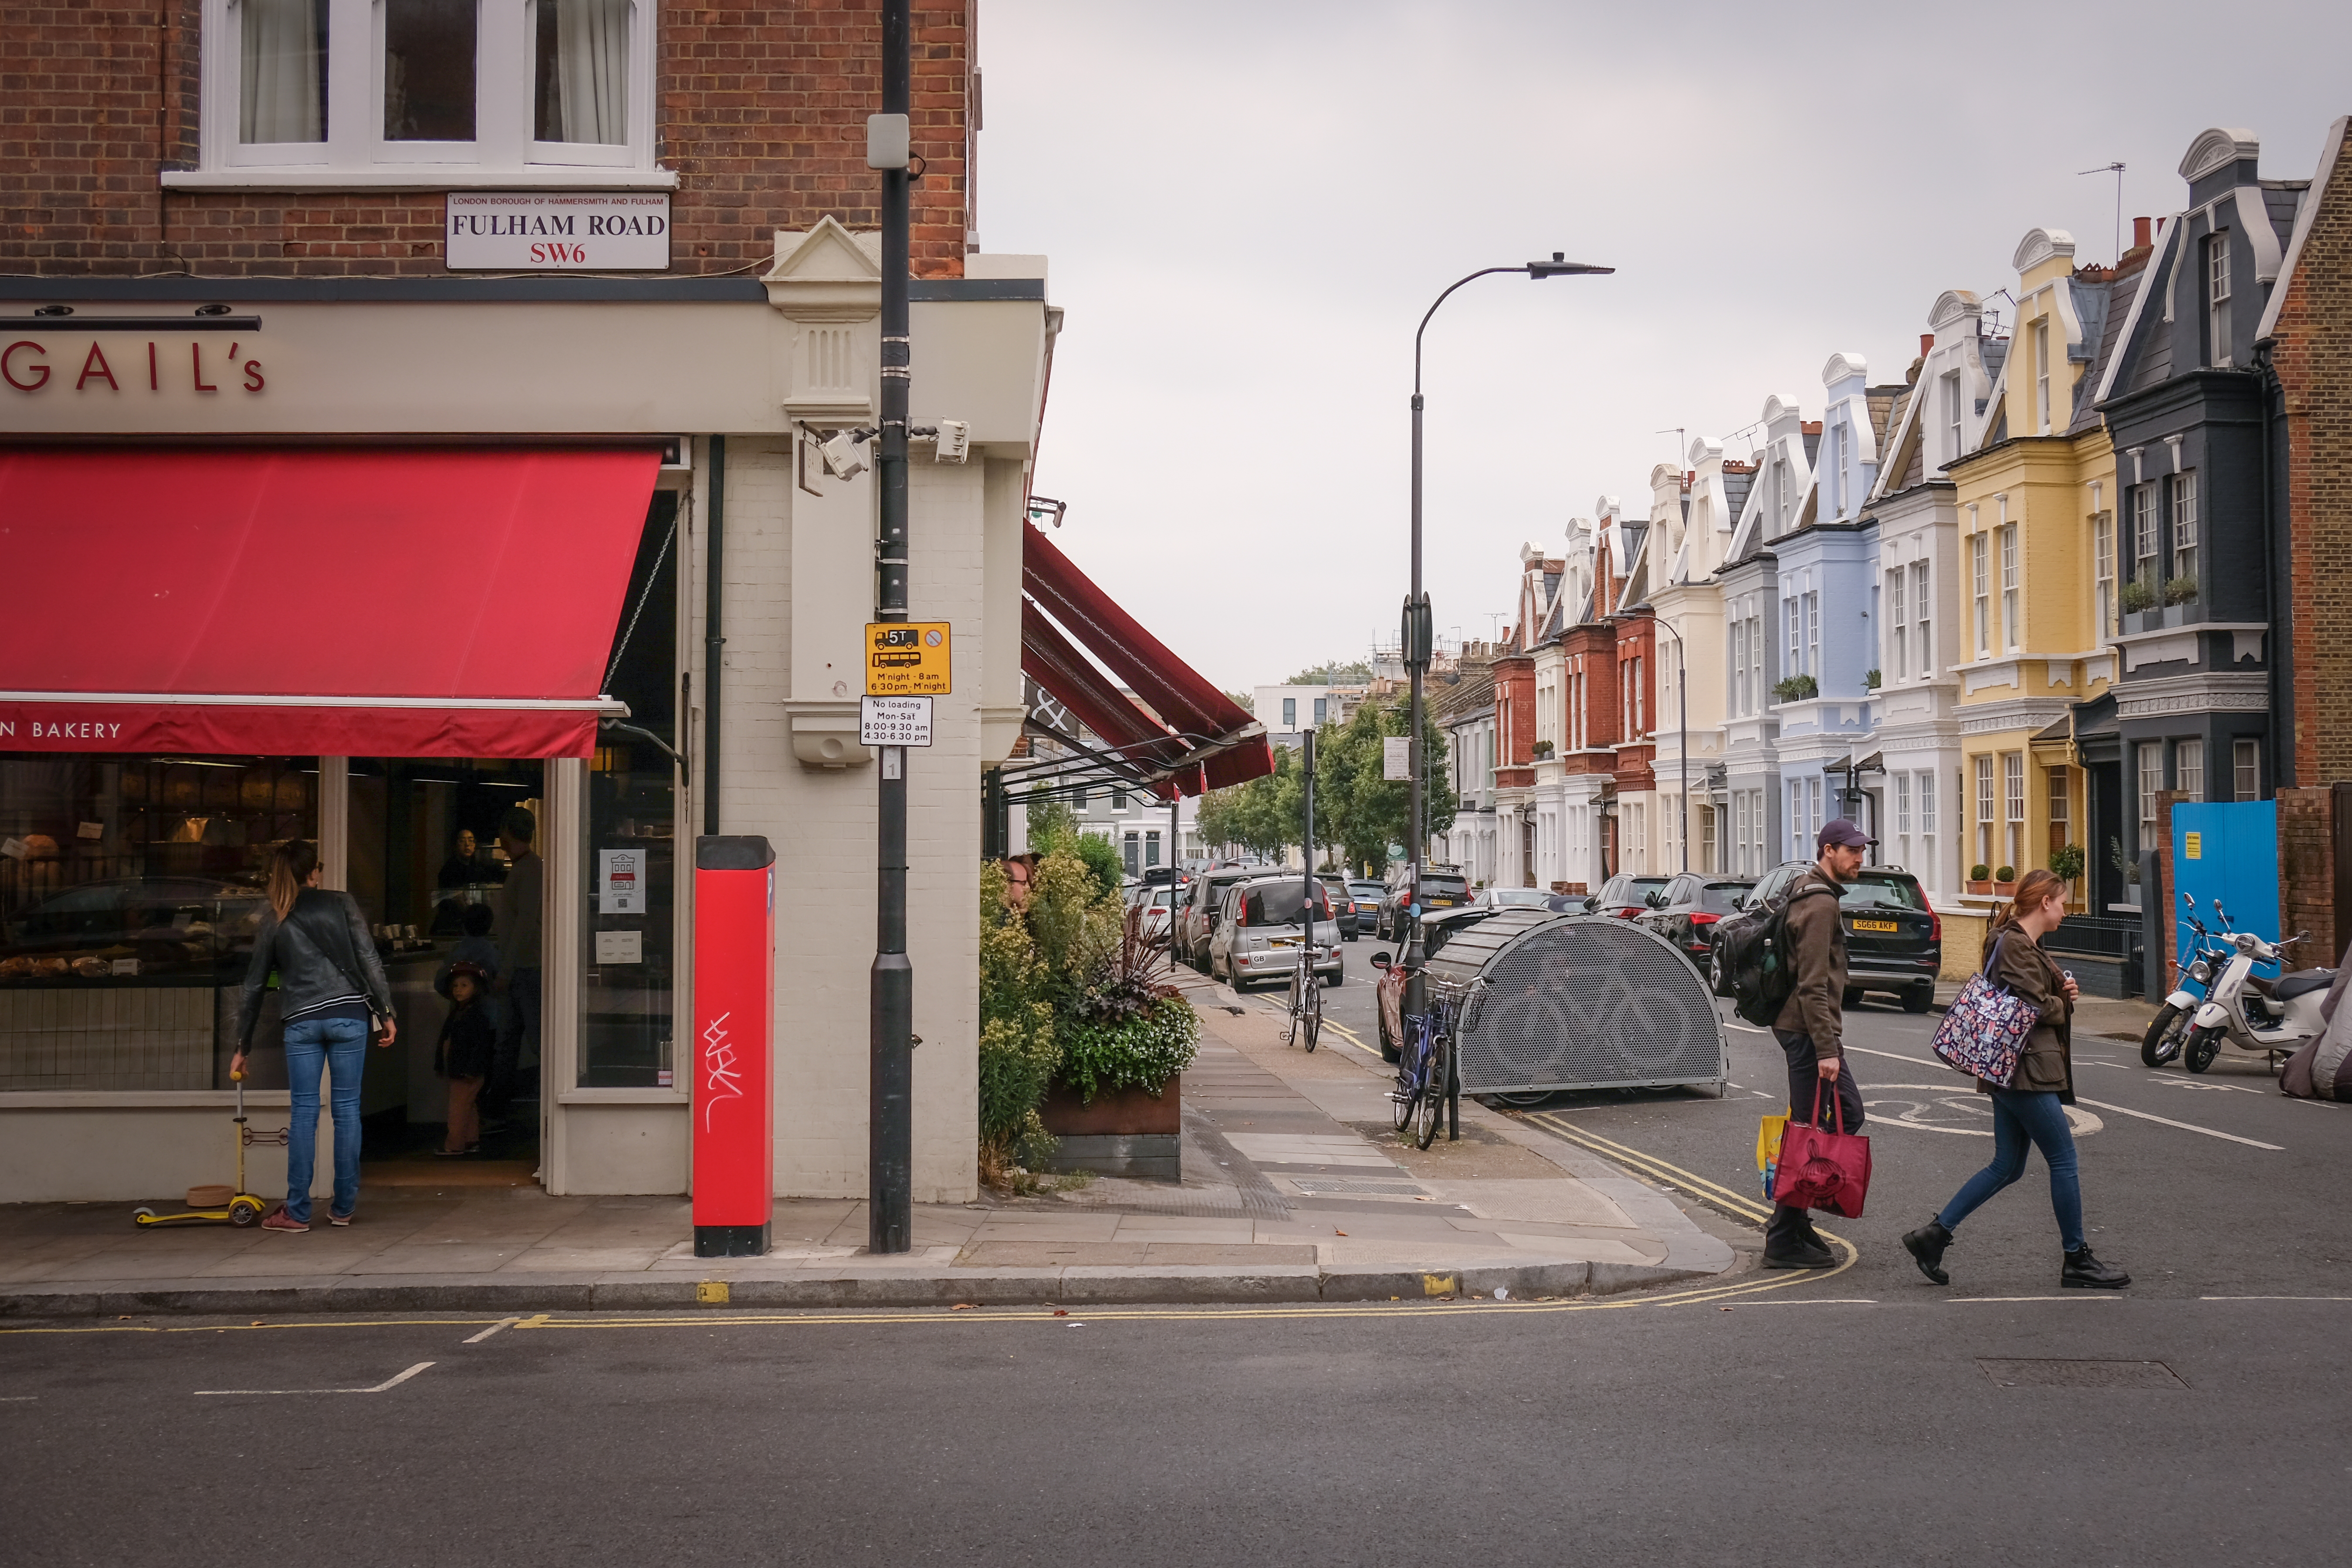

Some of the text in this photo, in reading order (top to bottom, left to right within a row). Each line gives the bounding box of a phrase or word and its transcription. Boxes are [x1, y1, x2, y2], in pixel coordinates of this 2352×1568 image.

[451, 215, 665, 236] FULHAM ROAD
[530, 243, 585, 263] SW6
[1, 340, 264, 392] GAIL's
[889, 701, 920, 710] loading
[33, 723, 121, 738] BAKERY
[865, 722, 911, 731] 8.00-9.30
[864, 732, 911, 740] 4.30-6.30
[768, 873, 772, 908] P
[1857, 920, 1877, 928] SG66
